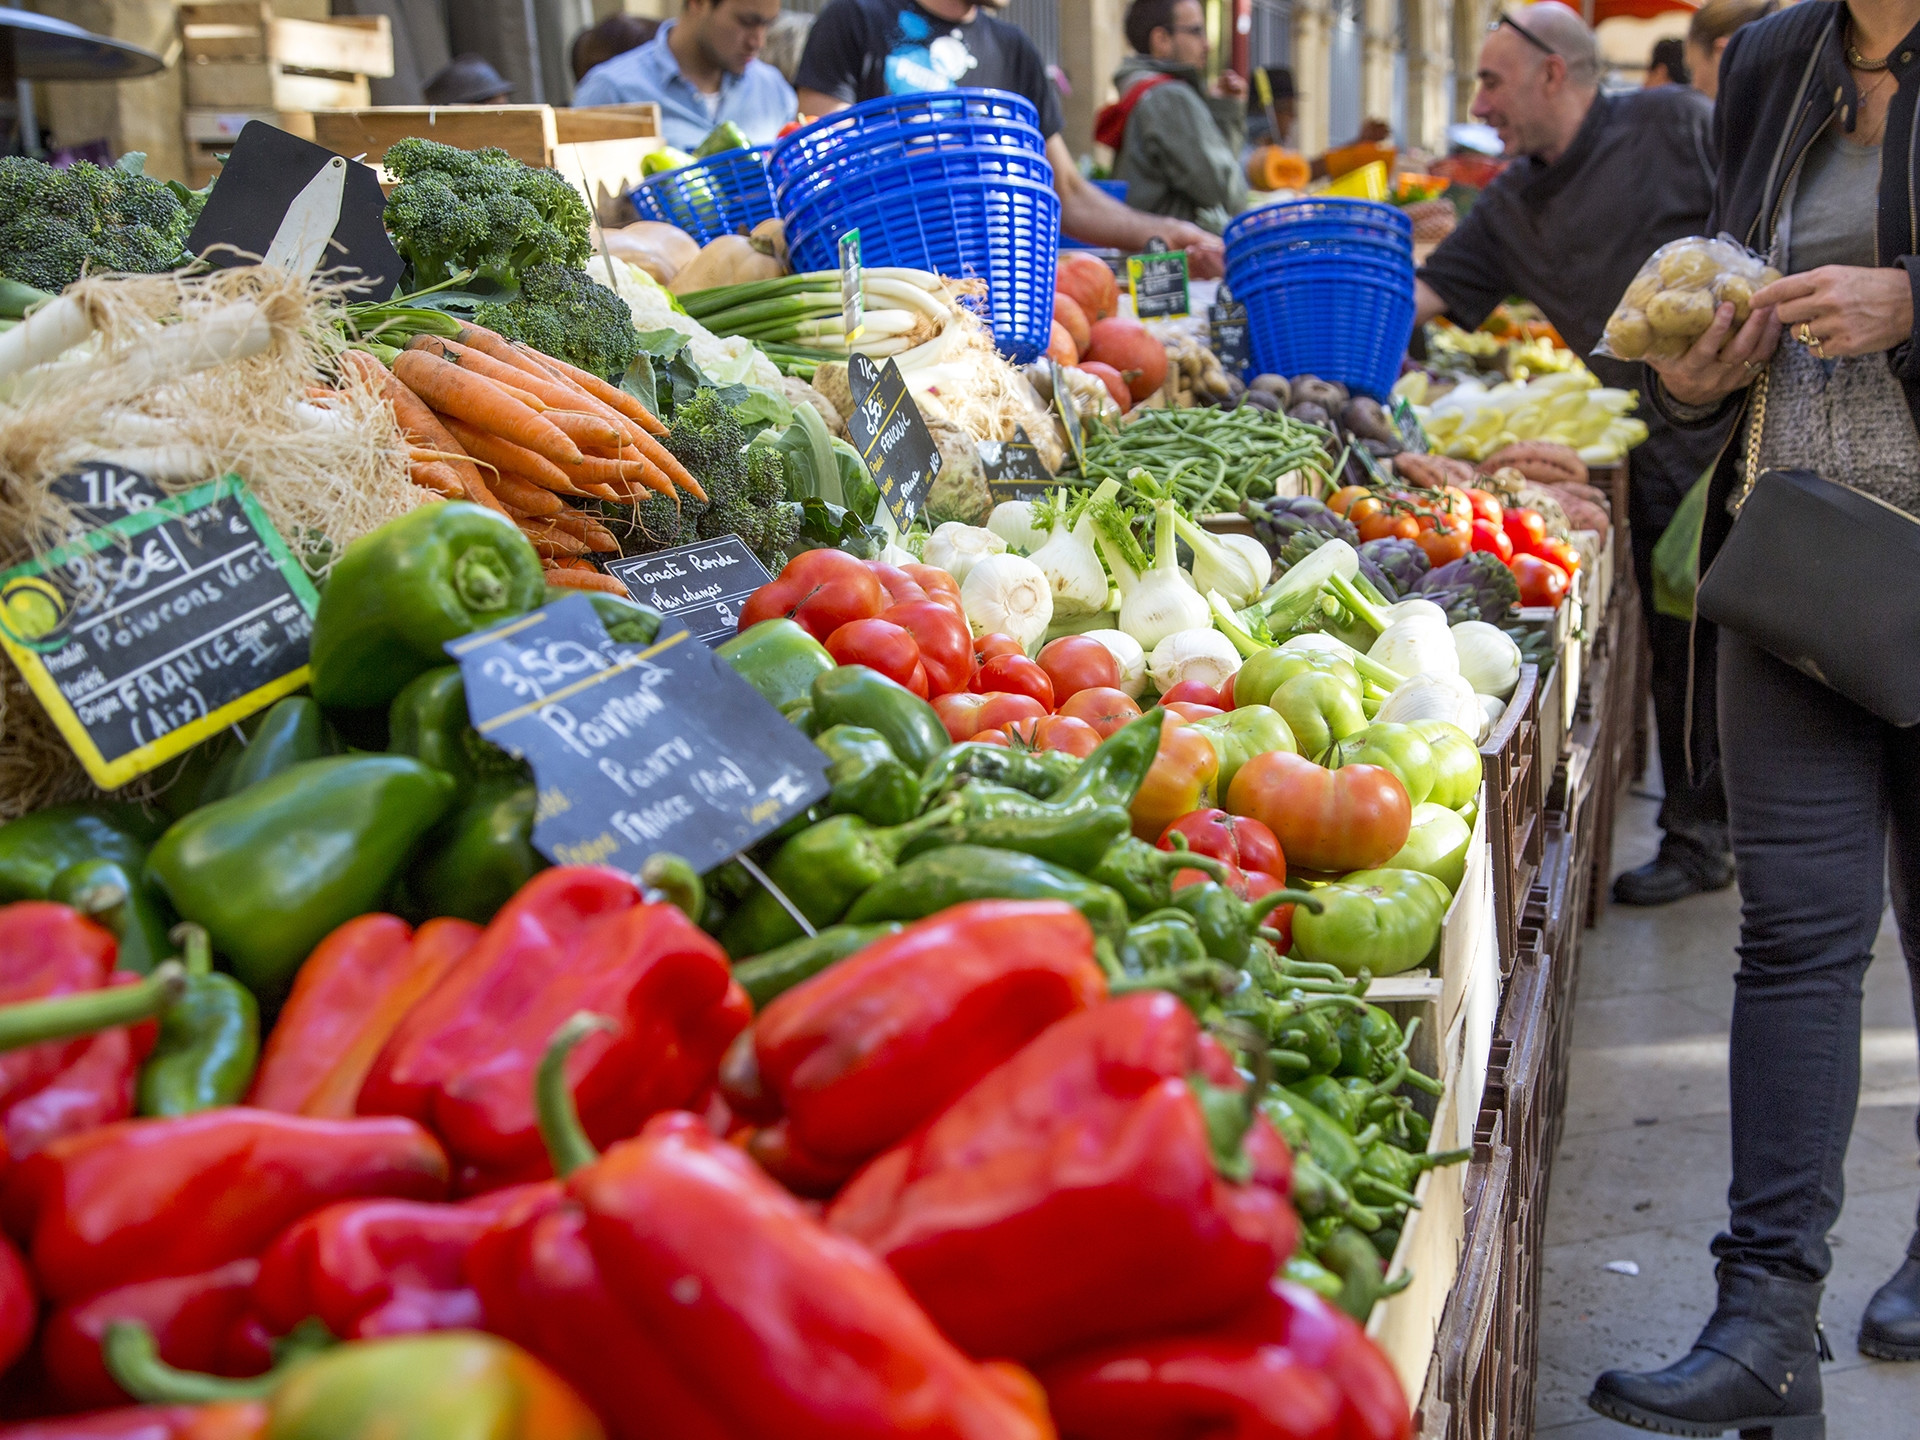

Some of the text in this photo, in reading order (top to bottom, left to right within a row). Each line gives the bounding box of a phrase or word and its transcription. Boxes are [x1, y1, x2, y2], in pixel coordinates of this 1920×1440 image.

[622, 551, 739, 585] Tomate Ronde
[92, 581, 223, 650] Poivrons
[78, 695, 122, 726] Origine
